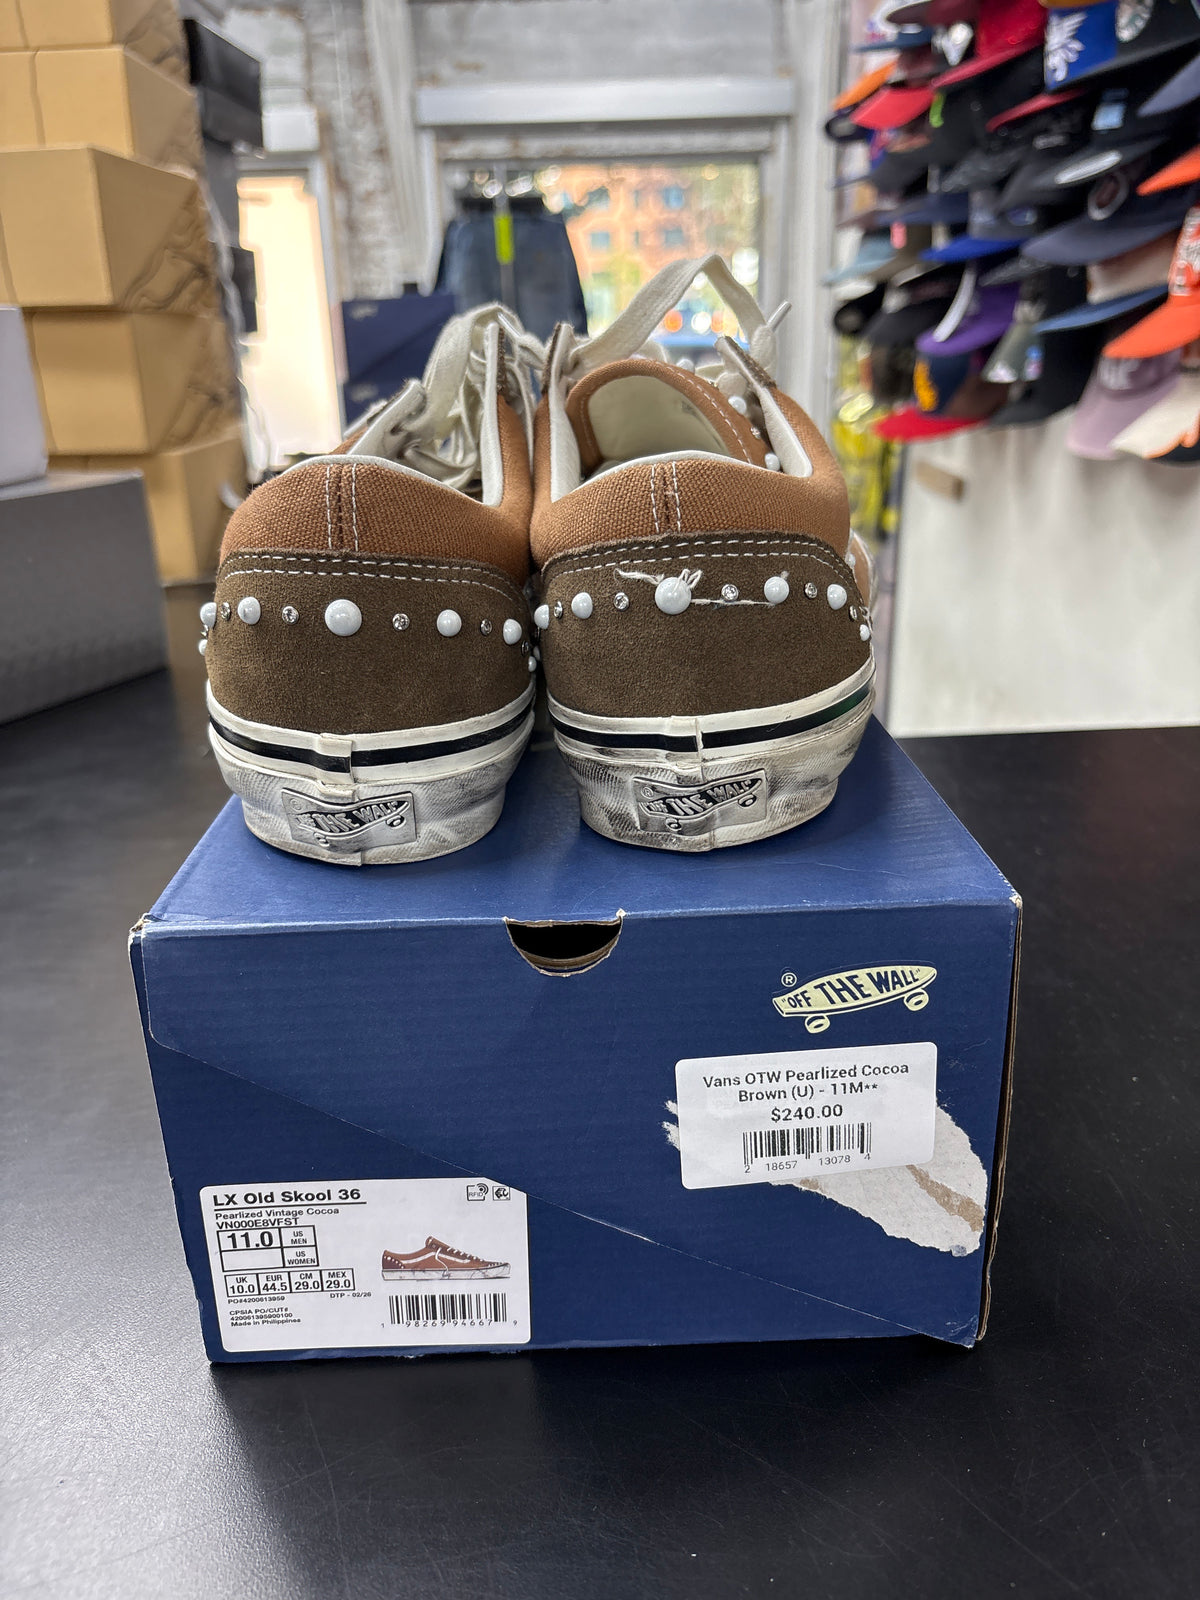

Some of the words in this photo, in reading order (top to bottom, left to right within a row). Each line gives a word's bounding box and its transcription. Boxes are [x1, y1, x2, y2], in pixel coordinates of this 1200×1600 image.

[667, 794, 713, 816] THE
[312, 813, 360, 832] THE
[814, 974, 871, 1004] THE
[703, 1075, 741, 1088] Vans
[745, 1071, 782, 1084] OTW
[786, 1066, 857, 1082] Pearlized
[862, 1064, 909, 1076] Cocoa
[738, 1088, 787, 1102] Brown
[792, 1084, 815, 1101] (U)
[771, 1104, 843, 1122] $240.00
[766, 1160, 798, 1171] 18657
[819, 1155, 851, 1166] 13078
[213, 1193, 238, 1206] LX
[244, 1191, 275, 1204] Old
[281, 1189, 331, 1203] Skool
[338, 1188, 361, 1200] 36
[215, 1211, 263, 1220] Pearlized
[266, 1208, 304, 1217] Vintage
[307, 1207, 339, 1215] Cocoa
[227, 1231, 274, 1249] 11.0
[266, 1274, 283, 1282] EUR
[299, 1272, 313, 1280] CM
[326, 1279, 351, 1289] 29.0
[230, 1284, 255, 1294] 10.0
[263, 1282, 288, 1292] 44.5
[295, 1280, 320, 1290] 29.0
[262, 1317, 302, 1326] Philippines
